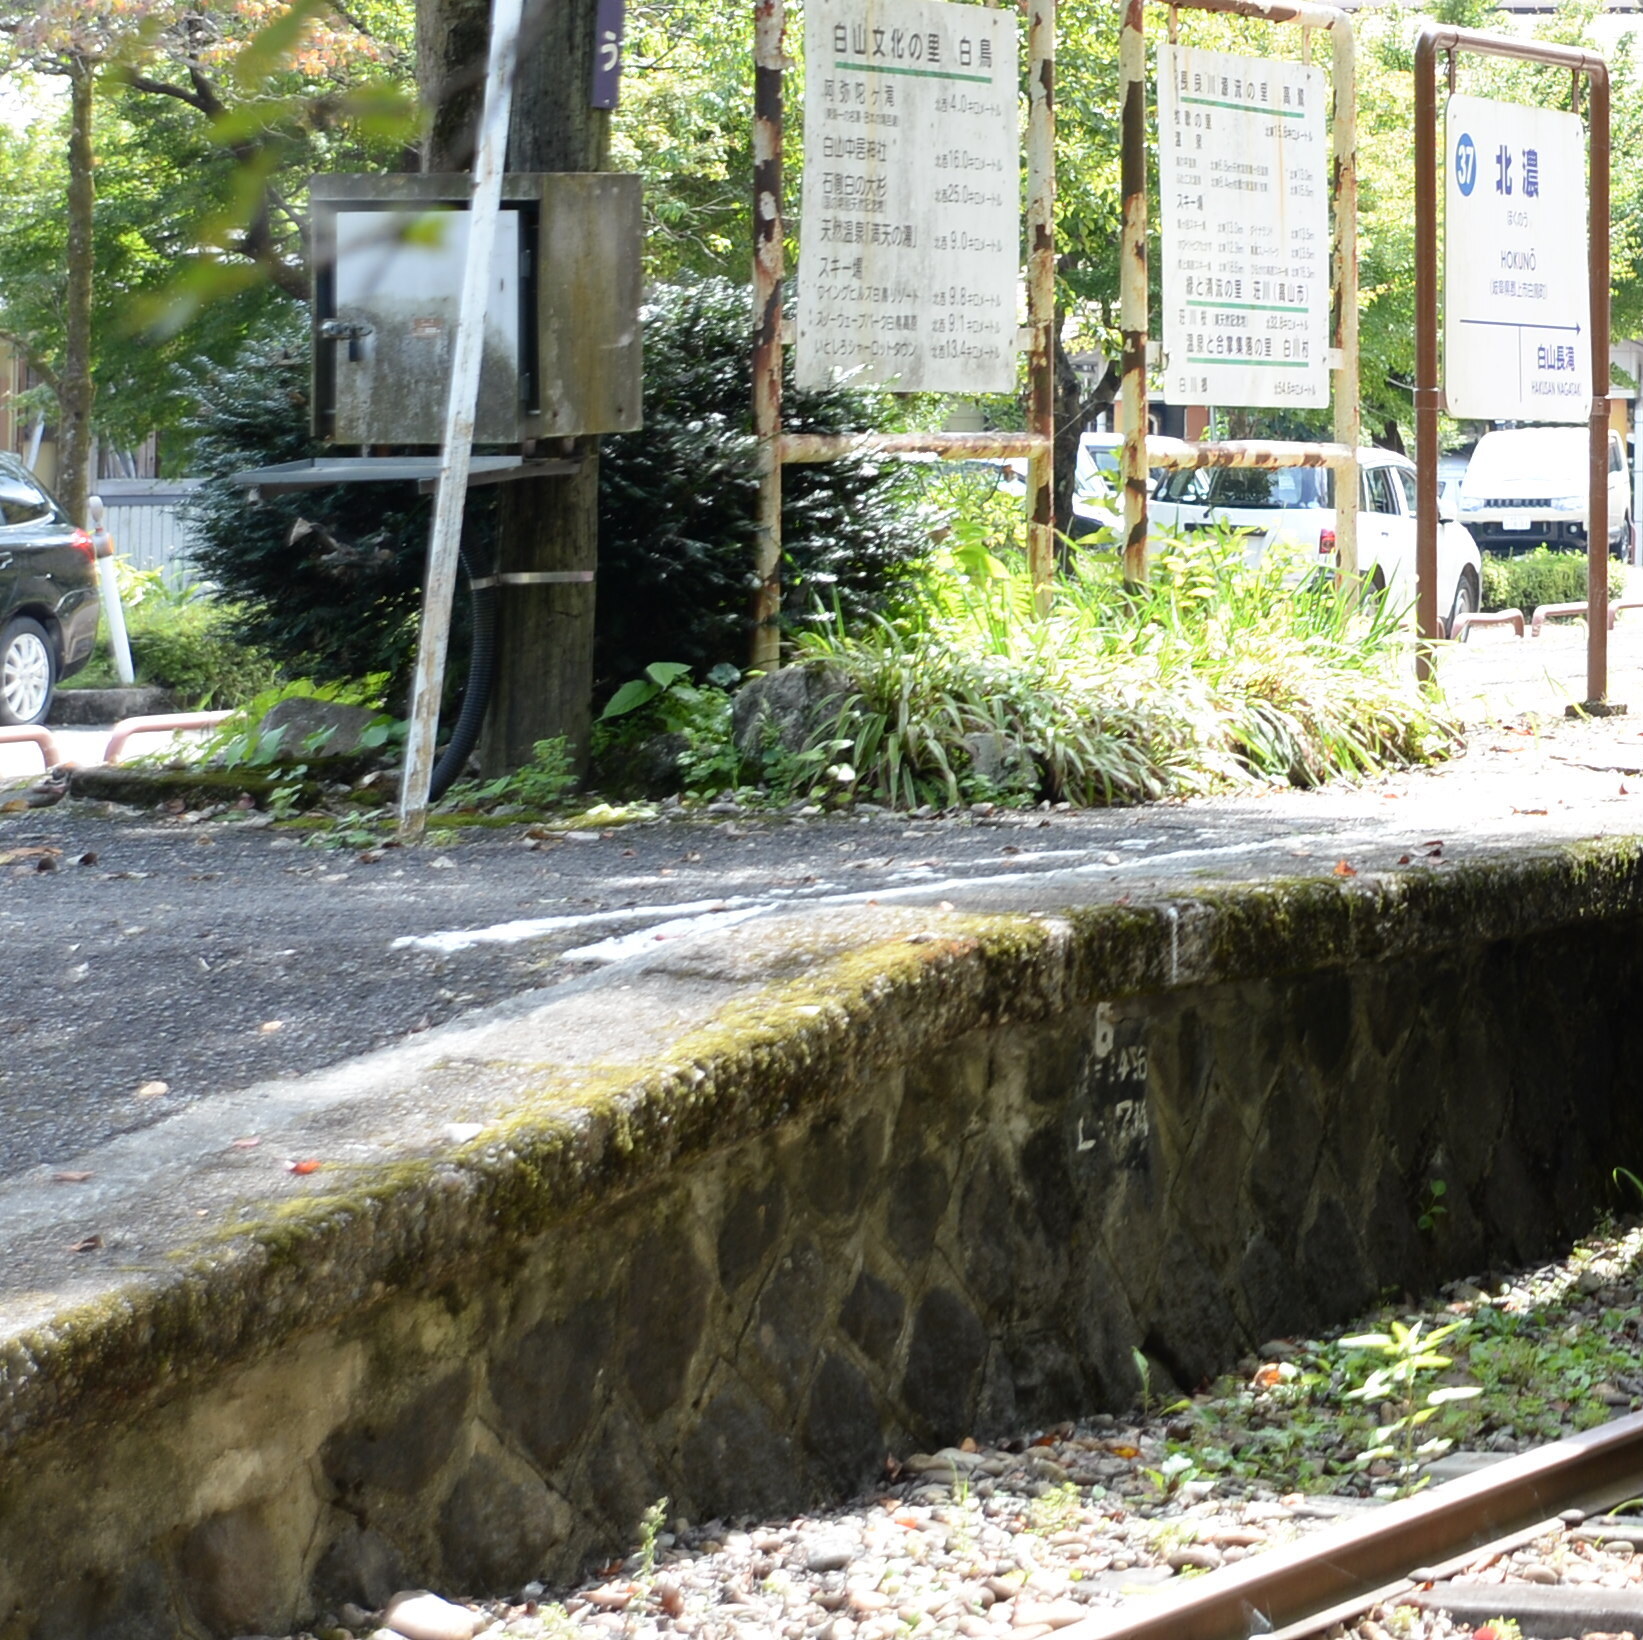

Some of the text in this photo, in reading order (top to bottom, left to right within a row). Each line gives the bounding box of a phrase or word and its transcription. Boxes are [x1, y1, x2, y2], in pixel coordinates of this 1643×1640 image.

[834, 22, 992, 68] 白山文化の里 白鳥
[1457, 144, 1474, 185] 37
[1495, 144, 1539, 198] 北濃
[818, 256, 863, 280] スキー場
[1537, 343, 1575, 371] 白山長滝
